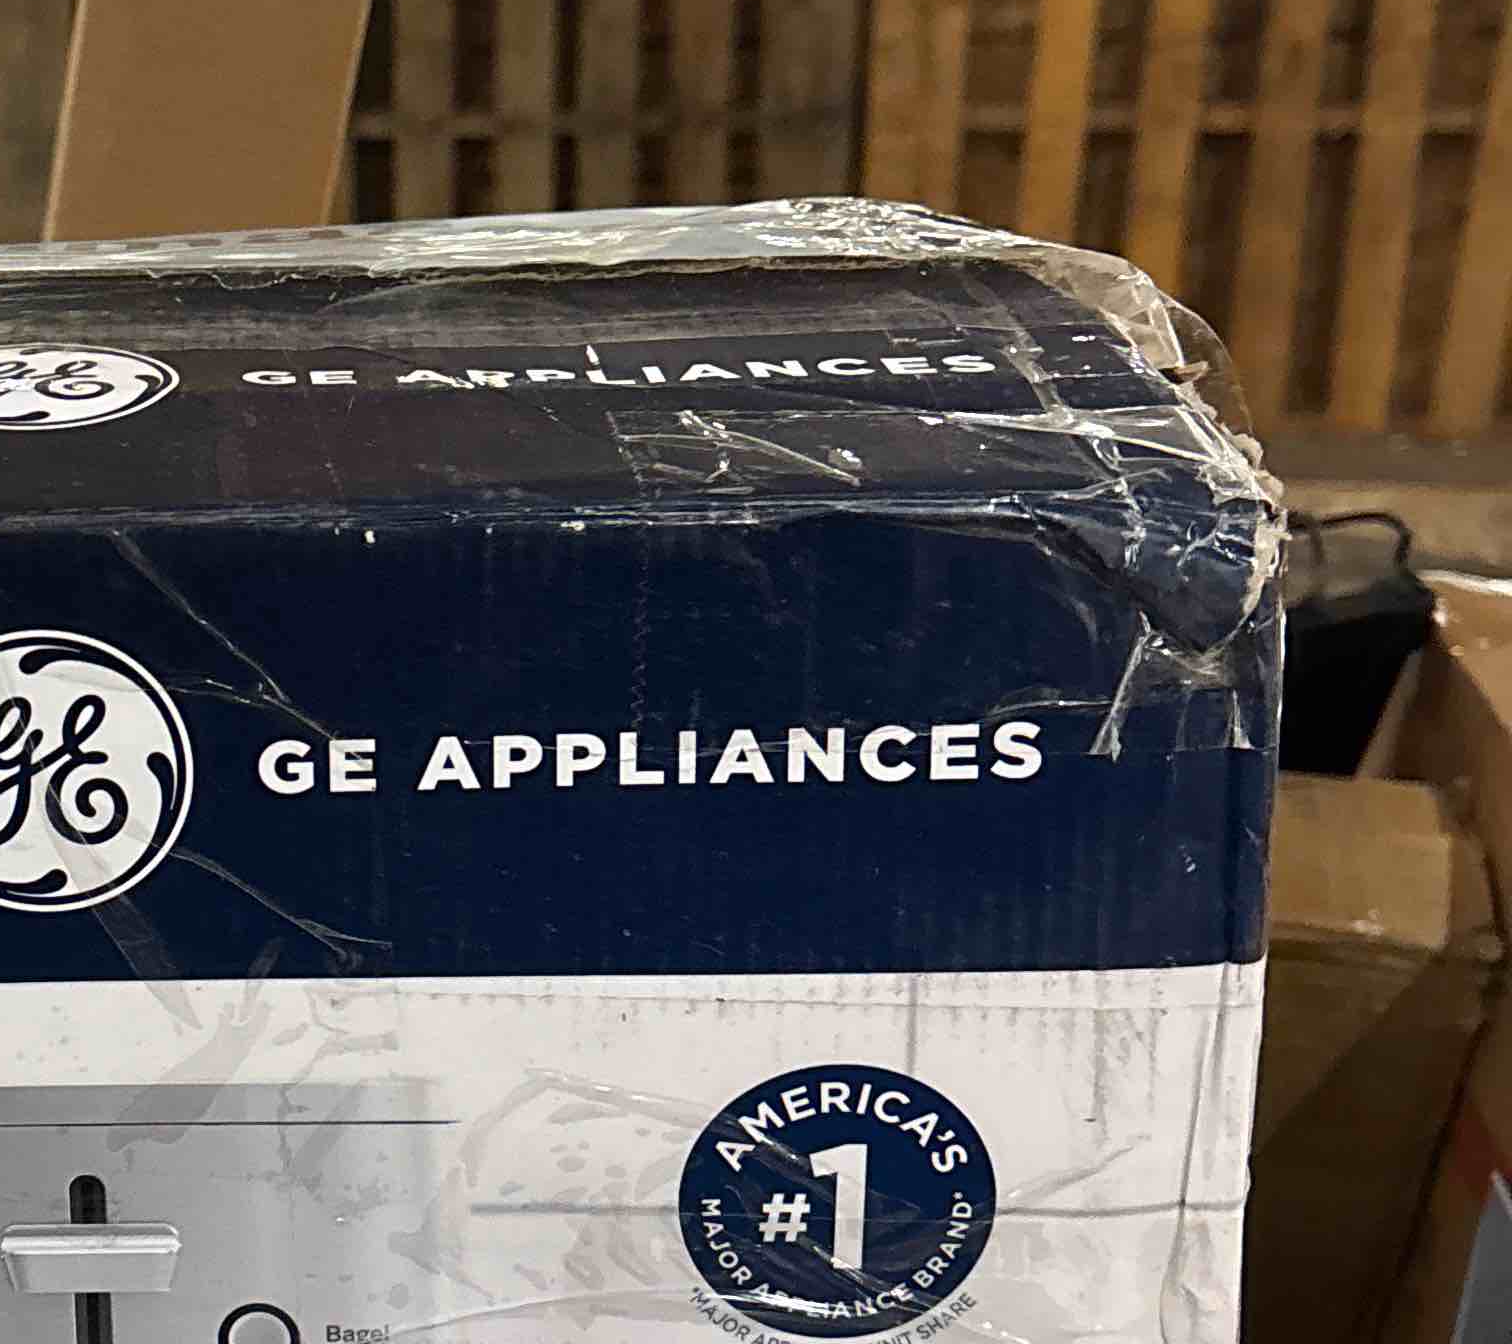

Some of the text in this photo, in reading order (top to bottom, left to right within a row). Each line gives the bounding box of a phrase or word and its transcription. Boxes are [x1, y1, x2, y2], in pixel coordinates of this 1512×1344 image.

[240, 368, 358, 386] GE
[257, 719, 1044, 795] GE APPLIANCES
[715, 1081, 969, 1174] AMERICA'S
[700, 1197, 754, 1286] MAJOR
[916, 1290, 978, 1342] SHARE
